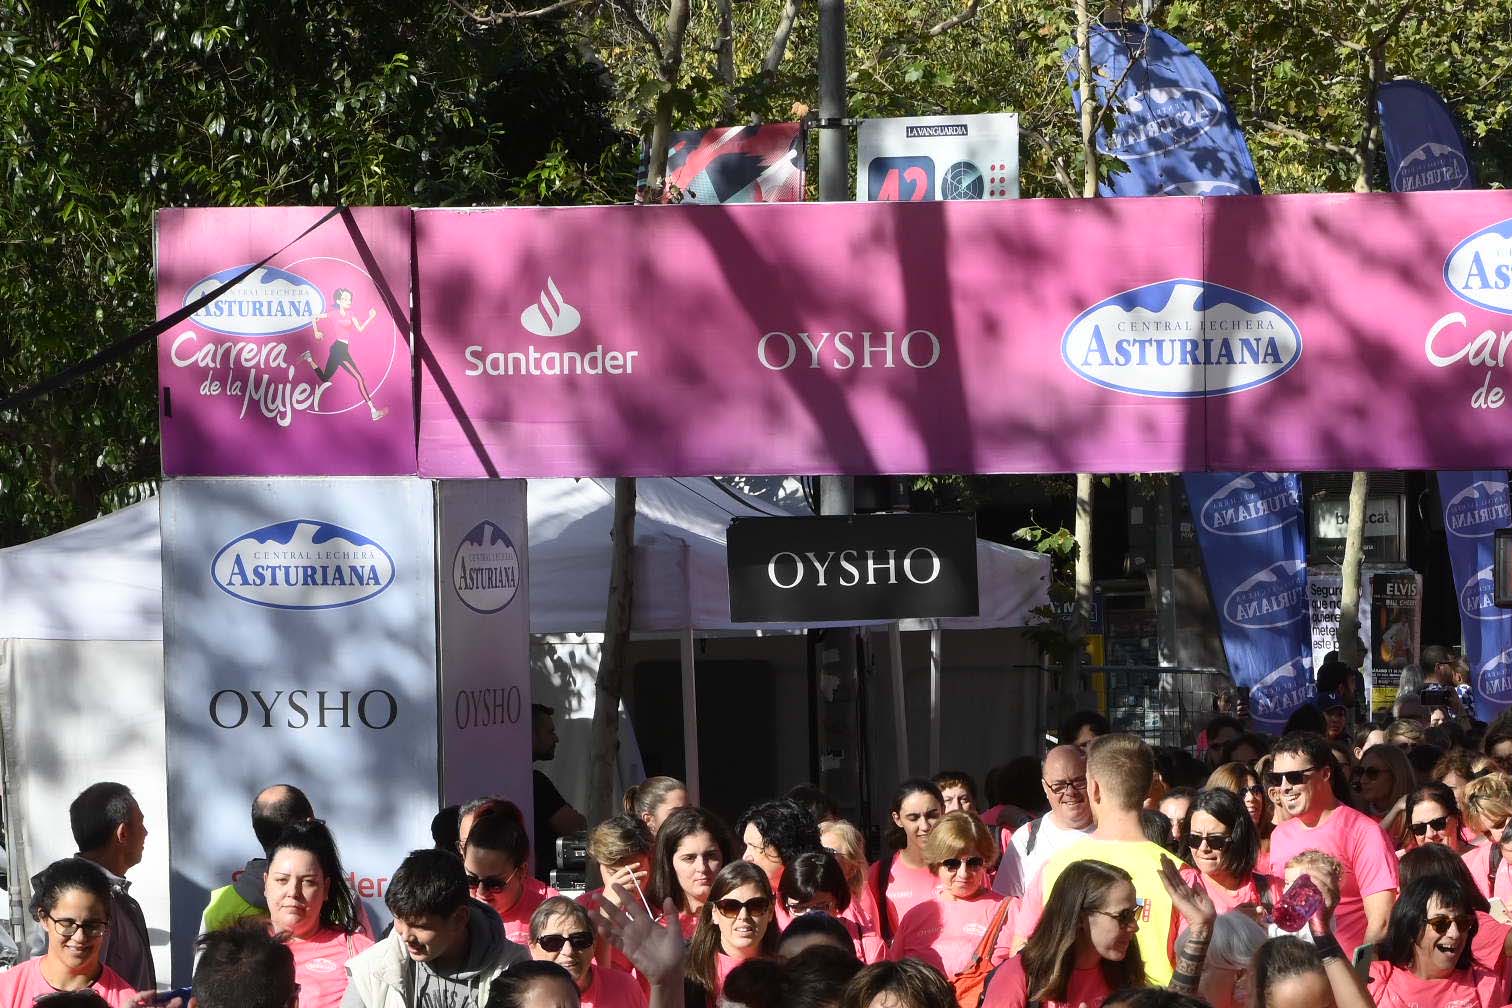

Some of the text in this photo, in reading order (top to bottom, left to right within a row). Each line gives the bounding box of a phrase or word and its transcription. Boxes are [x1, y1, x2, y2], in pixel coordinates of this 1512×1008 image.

[908, 126, 967, 136] LA VANGUARDIA
[194, 290, 313, 317] ASTURIANA
[1117, 320, 1275, 332] CENTRAL LECHERA
[170, 331, 288, 368] Carrera
[465, 344, 639, 376] Santander
[757, 330, 941, 371] OYSHO
[1081, 324, 1283, 367] ASTURIANA
[200, 365, 333, 427] de la Mujer
[1471, 374, 1505, 410] de
[226, 553, 382, 587] ASTURIANA
[253, 551, 375, 560] CENTRAL LECHERA
[768, 547, 941, 589] OYSHO
[458, 561, 517, 591] ASTURIANA
[1386, 583, 1417, 596] ELVIS
[1312, 600, 1328, 612] que
[1313, 640, 1332, 650] este
[209, 689, 398, 730] OYSHO
[455, 685, 521, 730] OYSHO
